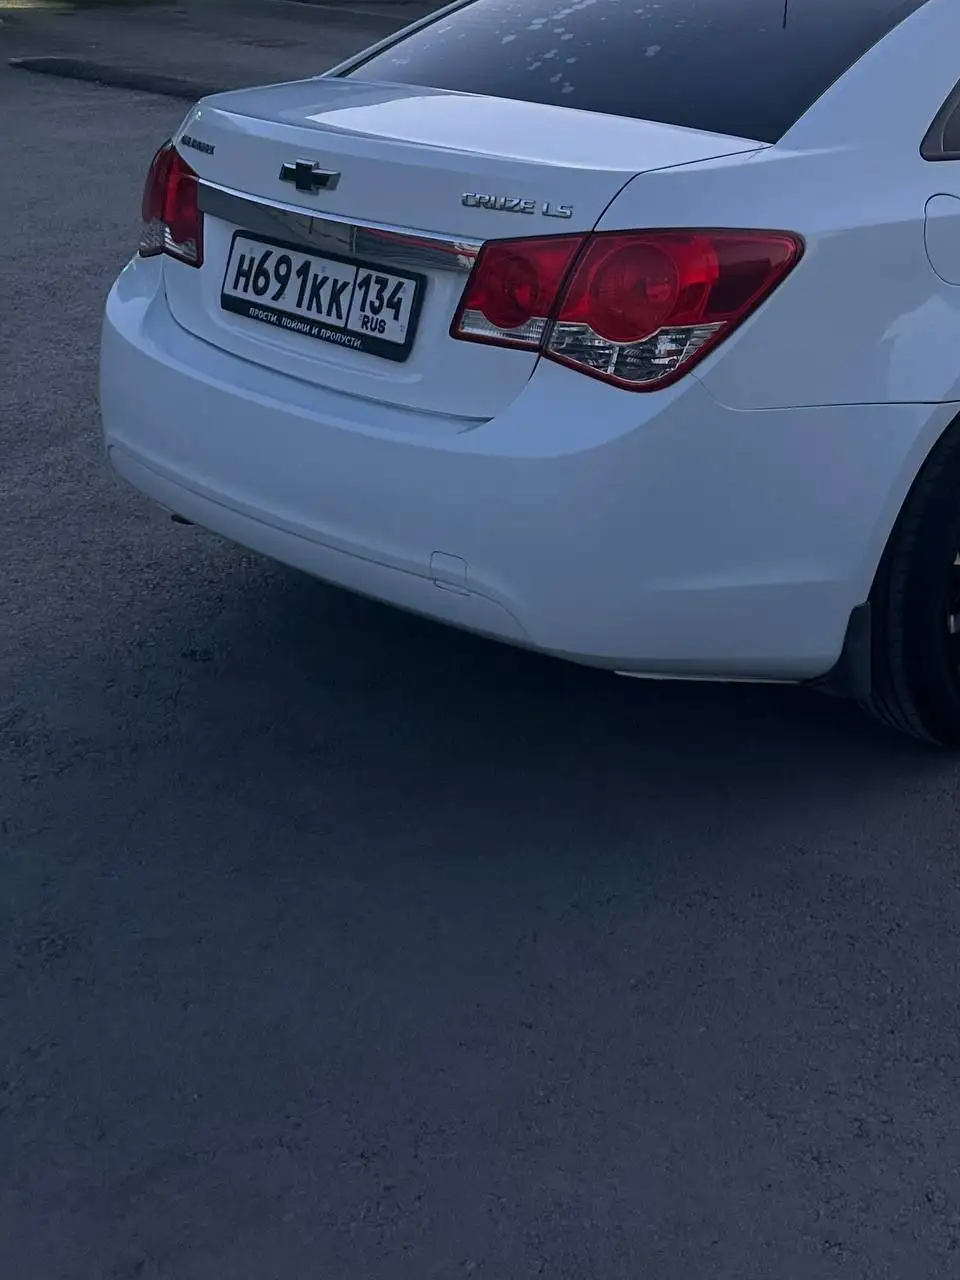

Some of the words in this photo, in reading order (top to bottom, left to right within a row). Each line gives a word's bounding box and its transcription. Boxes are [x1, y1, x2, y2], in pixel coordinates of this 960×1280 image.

[461, 191, 536, 215] CRUZE
[541, 201, 574, 219] LS
[233, 250, 350, 320] Н691КК
[357, 273, 406, 321] 134
[312, 327, 319, 336] И
[360, 315, 388, 334] RUS
